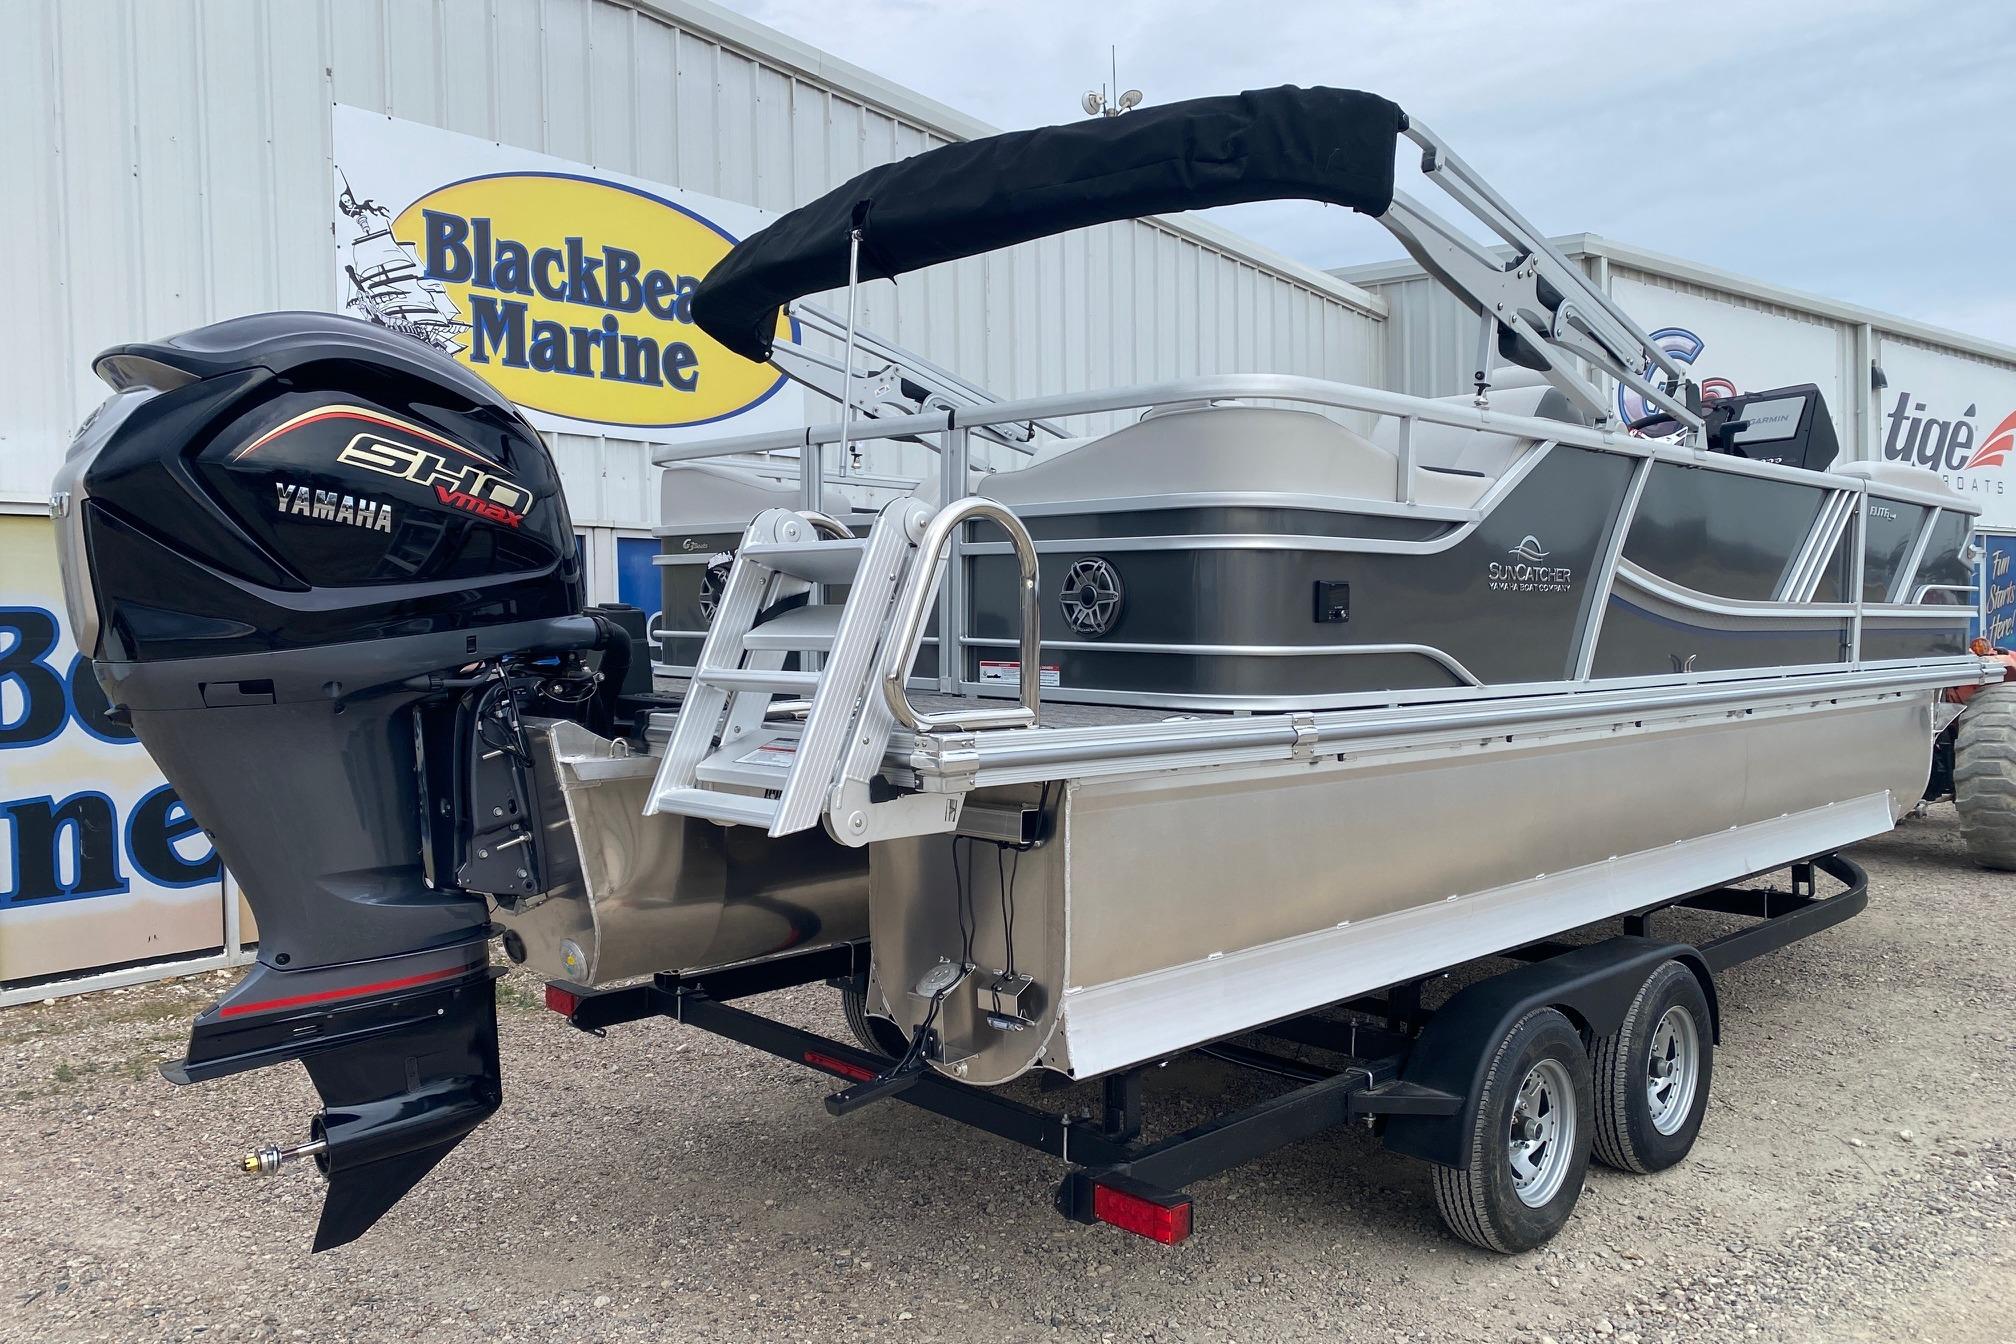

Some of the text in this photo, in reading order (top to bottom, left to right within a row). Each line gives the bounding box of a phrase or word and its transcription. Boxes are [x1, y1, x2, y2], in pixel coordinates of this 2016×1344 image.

[422, 208, 701, 324] BlackBea
[468, 294, 699, 392] Marine
[1748, 414, 1789, 426] GARMIN
[337, 432, 533, 516] SHO
[275, 482, 392, 533] YAMAHA
[1992, 550, 2010, 580] Fun
[1488, 582, 1571, 592] YAMAHA BOAT COMPANY
[1987, 580, 2015, 614] Starts
